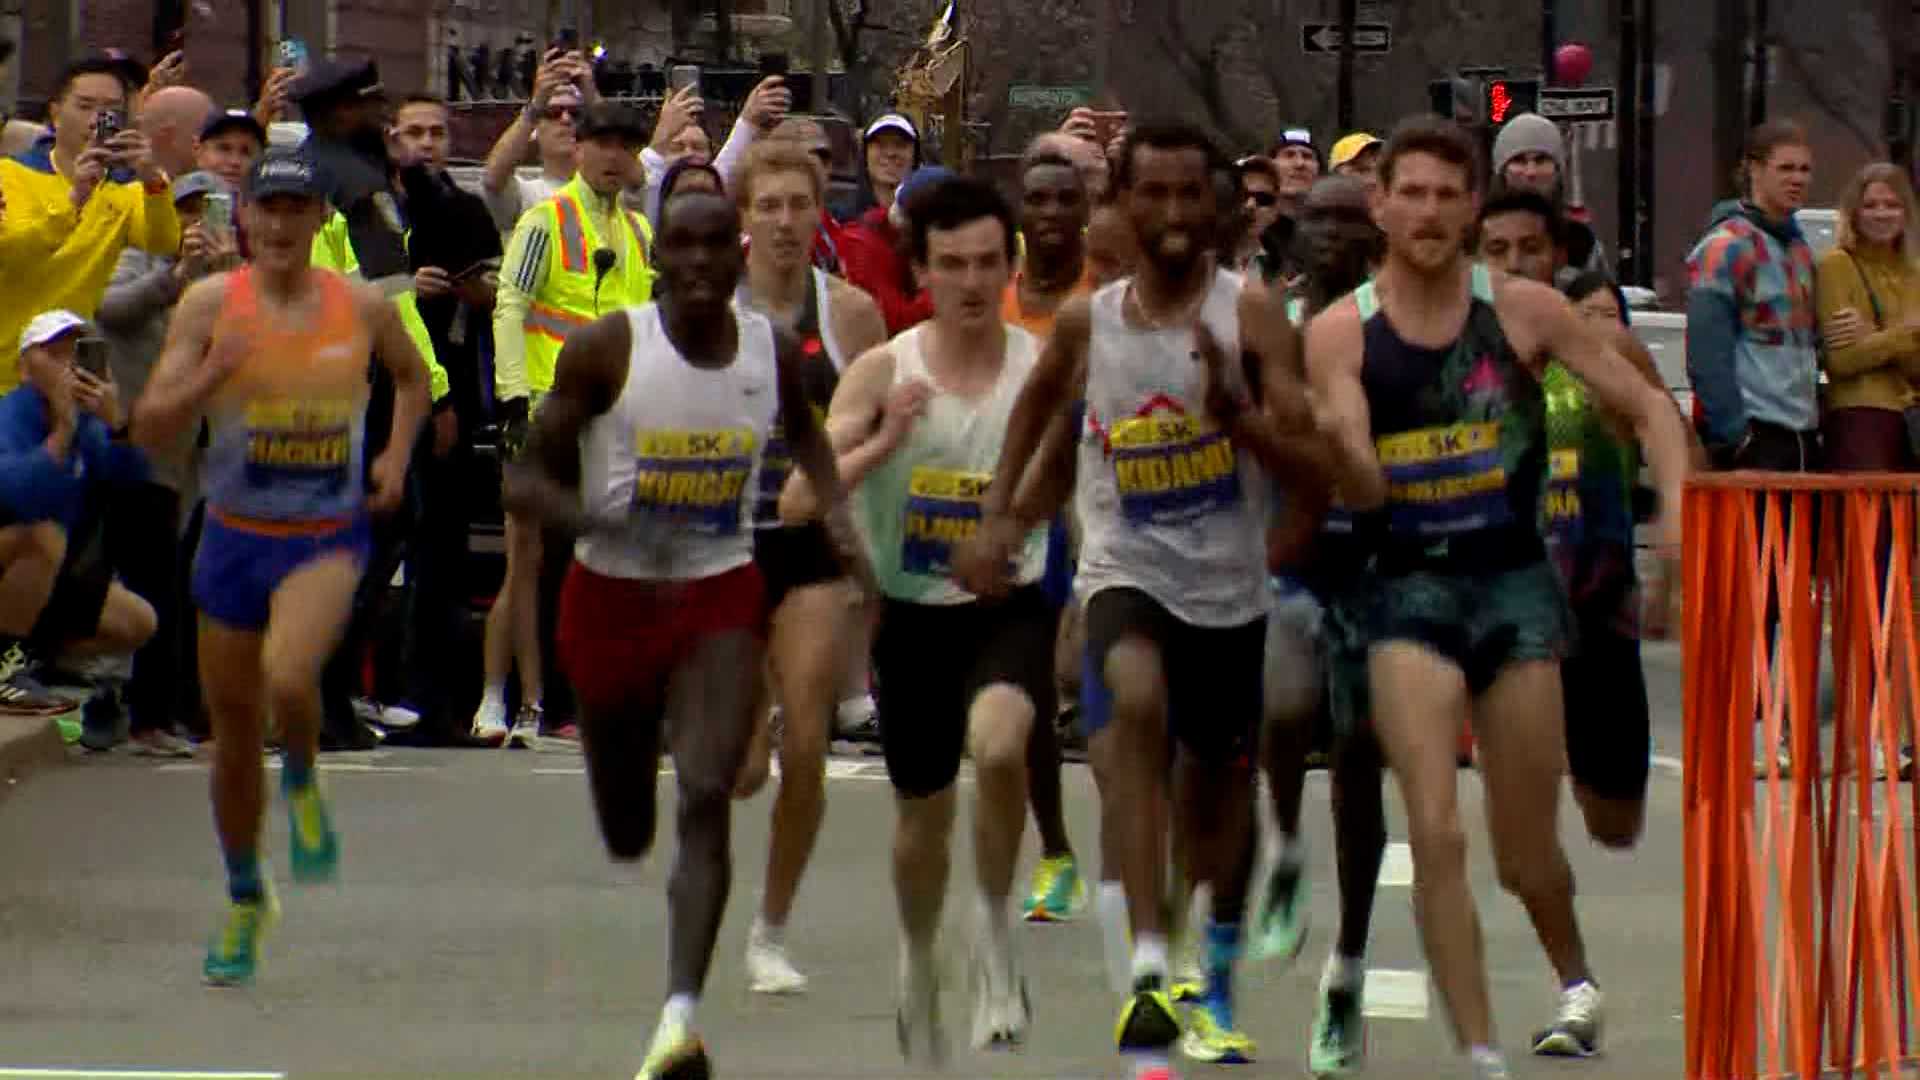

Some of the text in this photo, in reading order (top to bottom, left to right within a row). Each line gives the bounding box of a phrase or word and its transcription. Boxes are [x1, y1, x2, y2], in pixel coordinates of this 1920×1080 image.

[1157, 419, 1192, 441] 5K
[688, 432, 721, 457] 5K
[1426, 430, 1463, 457] 5K
[1116, 437, 1235, 495] KIDANU
